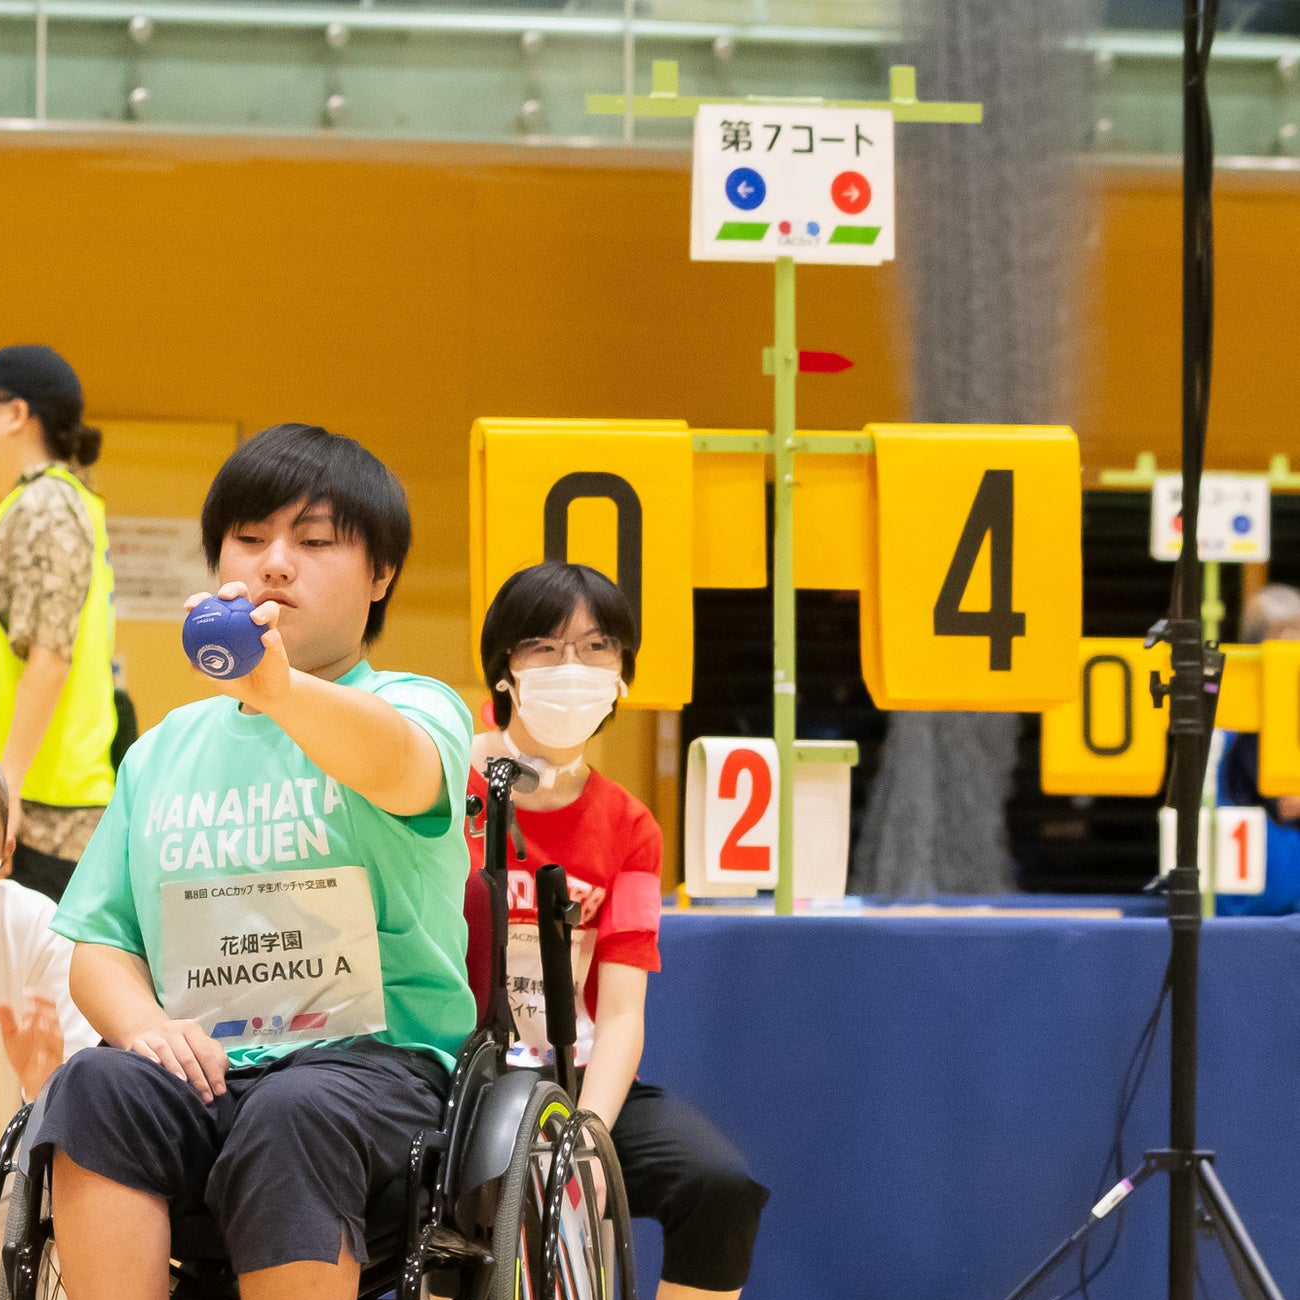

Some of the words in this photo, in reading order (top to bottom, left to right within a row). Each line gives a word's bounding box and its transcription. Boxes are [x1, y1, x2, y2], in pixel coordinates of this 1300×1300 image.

[932, 468, 1026, 672] 4
[1083, 654, 1133, 757] 0
[144, 774, 348, 838] HANAHATA
[718, 748, 773, 872] 2
[159, 818, 331, 872] GAKUEN
[1231, 819, 1249, 880] 1
[187, 958, 324, 990] HANAGAKU
[334, 956, 353, 976] A
[220, 929, 303, 957] 花畑学園
